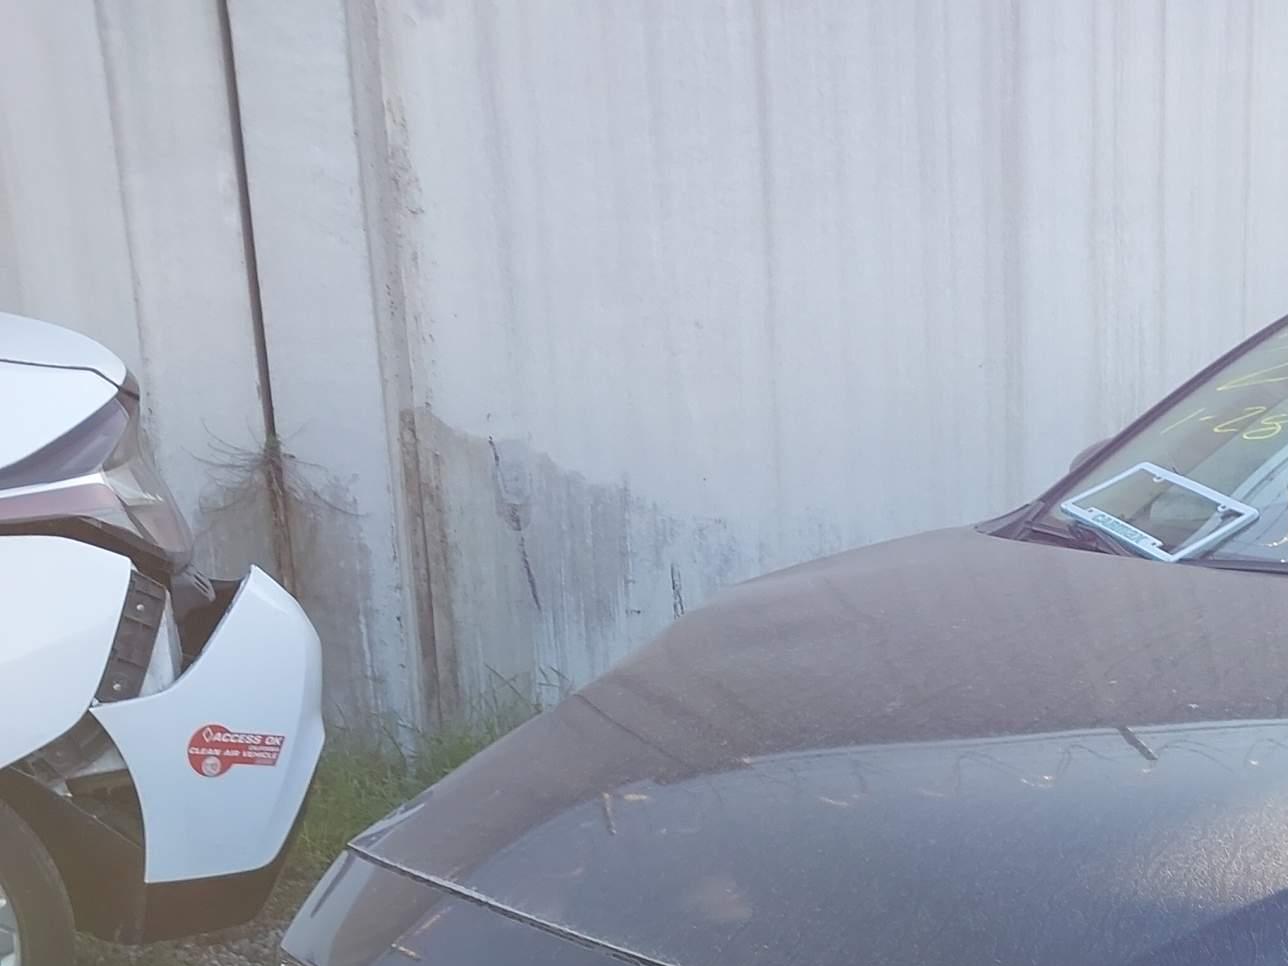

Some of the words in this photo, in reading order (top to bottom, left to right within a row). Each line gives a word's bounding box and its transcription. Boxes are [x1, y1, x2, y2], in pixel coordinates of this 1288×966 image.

[211, 732, 262, 745] ACCESS
[264, 736, 282, 745] OK
[188, 746, 222, 756] CLEAN
[223, 748, 241, 758] AIR
